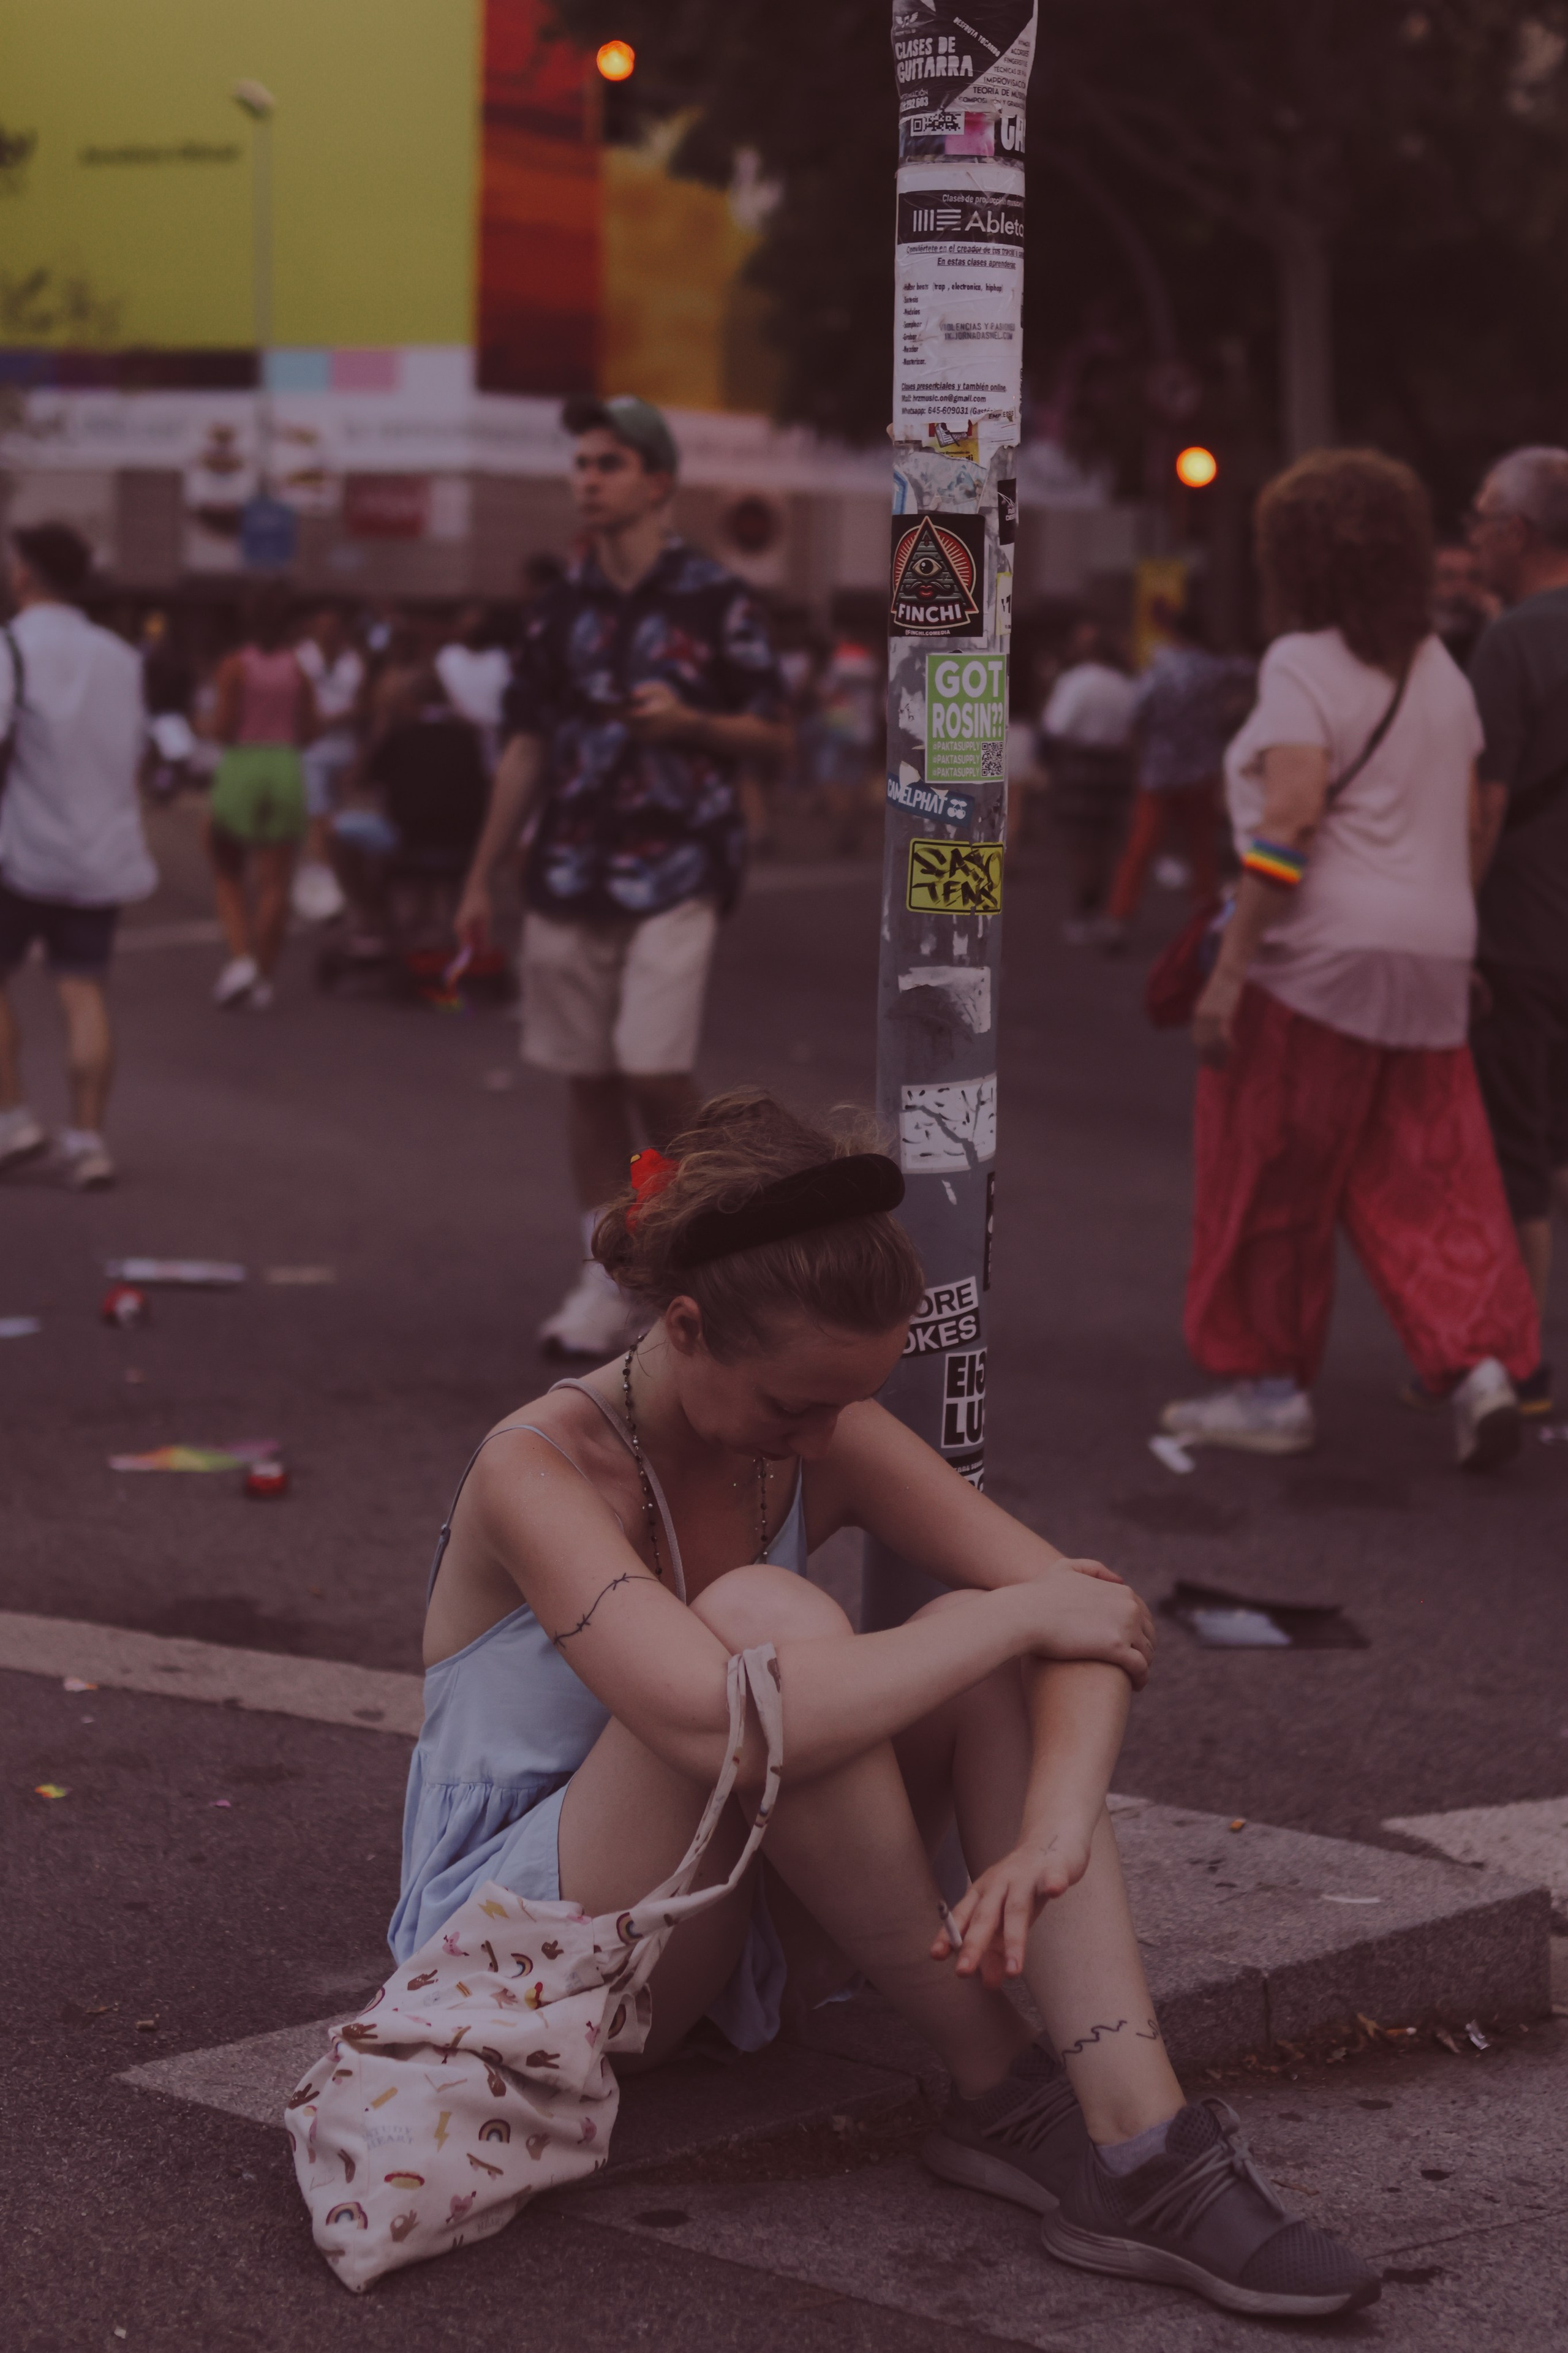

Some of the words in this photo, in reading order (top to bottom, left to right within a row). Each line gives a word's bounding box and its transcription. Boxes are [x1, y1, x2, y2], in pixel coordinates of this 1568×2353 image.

[895, 37, 933, 60] CLASES
[938, 36, 956, 55] DE
[897, 55, 973, 83] GUITARRA
[973, 85, 999, 95] TEORÍA
[1001, 88, 1009, 97] DE
[942, 194, 964, 203] Clases
[965, 195, 974, 203] de
[957, 244, 981, 253] creador
[916, 382, 956, 391] presenciales
[928, 406, 968, 415] 645-609031
[898, 603, 962, 622] FINCHI
[935, 660, 1003, 698] GOT
[932, 702, 1003, 738] ROSIN??
[933, 741, 979, 752] @PAKTASUPPLY
[933, 755, 979, 765] @PAKTASUPPLY
[933, 768, 979, 777] @PAKTASUPPLY
[888, 779, 948, 815] CAMELPHAT
